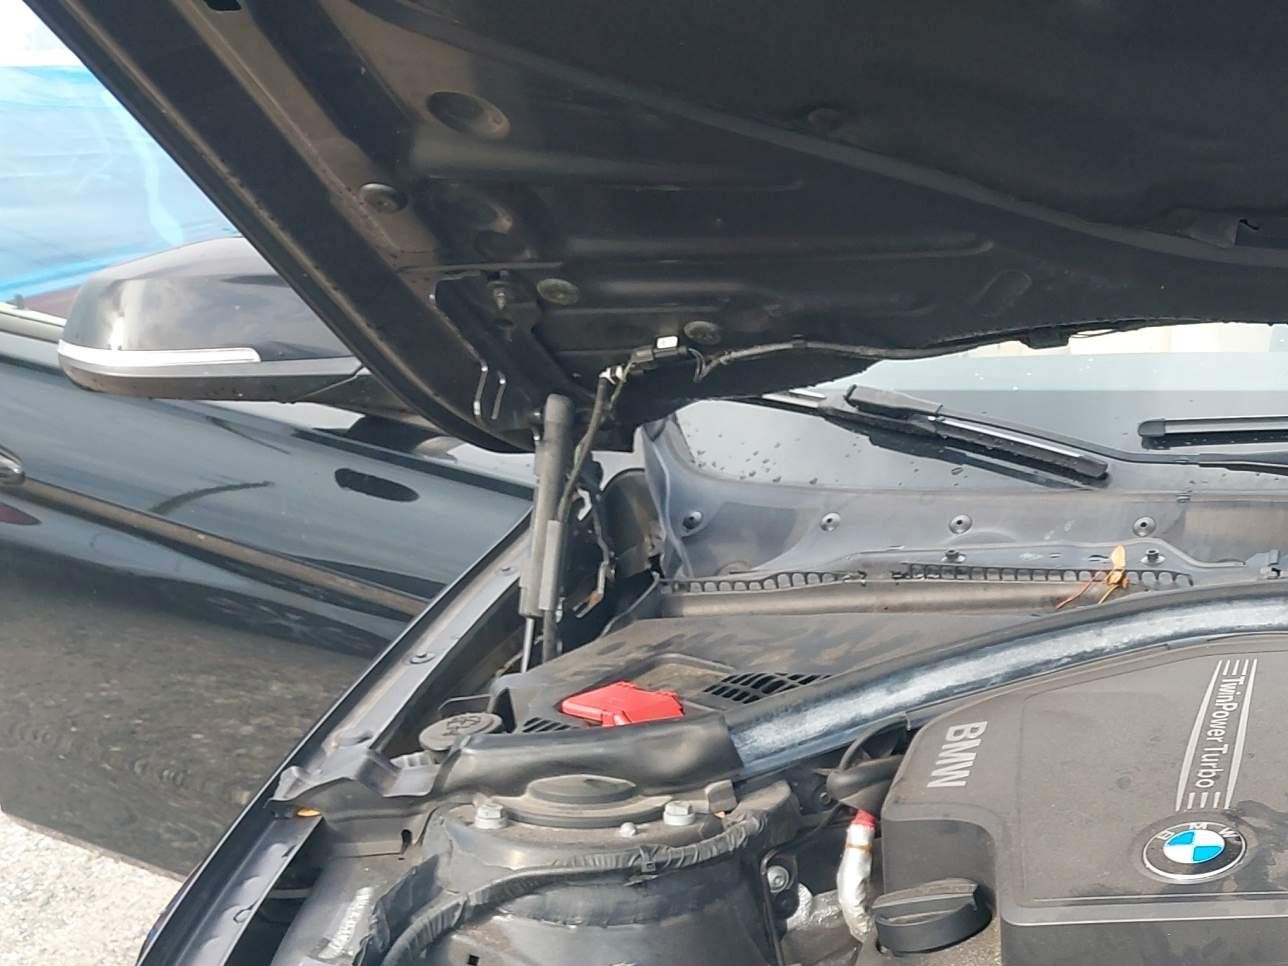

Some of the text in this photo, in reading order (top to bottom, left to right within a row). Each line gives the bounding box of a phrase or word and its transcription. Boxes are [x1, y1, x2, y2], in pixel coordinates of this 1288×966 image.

[926, 720, 989, 788] BMW
[1195, 675, 1246, 789] TwinPower Turbo
